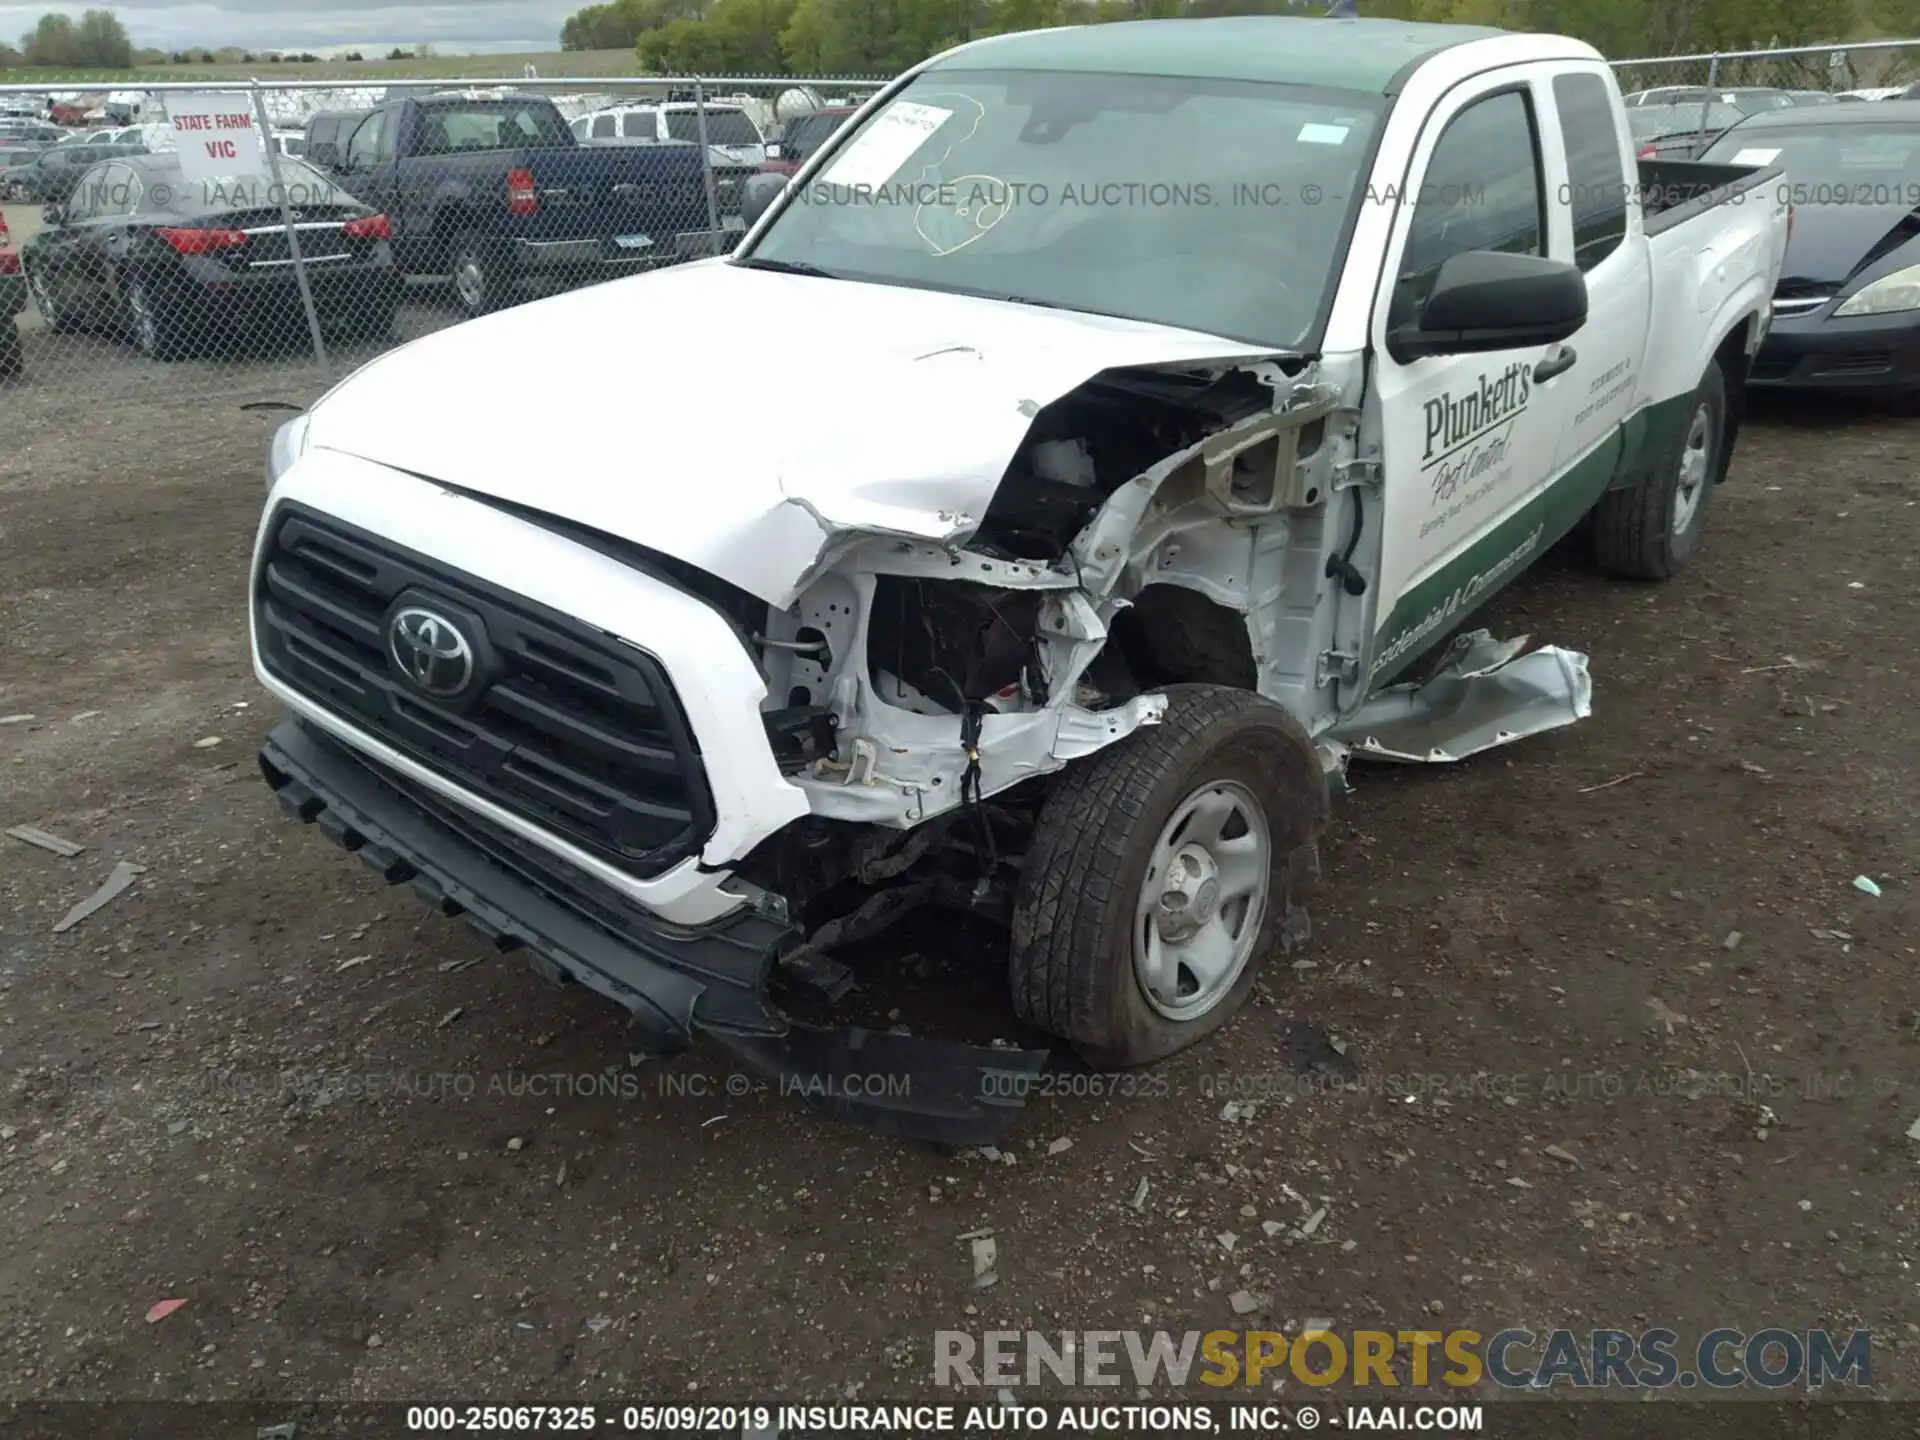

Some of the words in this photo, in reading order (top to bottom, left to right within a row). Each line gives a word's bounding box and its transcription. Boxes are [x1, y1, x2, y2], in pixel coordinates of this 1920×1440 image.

[172, 114, 212, 130] STATE
[214, 113, 252, 129] FARM
[204, 140, 236, 158] VIC
[1422, 361, 1531, 461] Plunkett's
